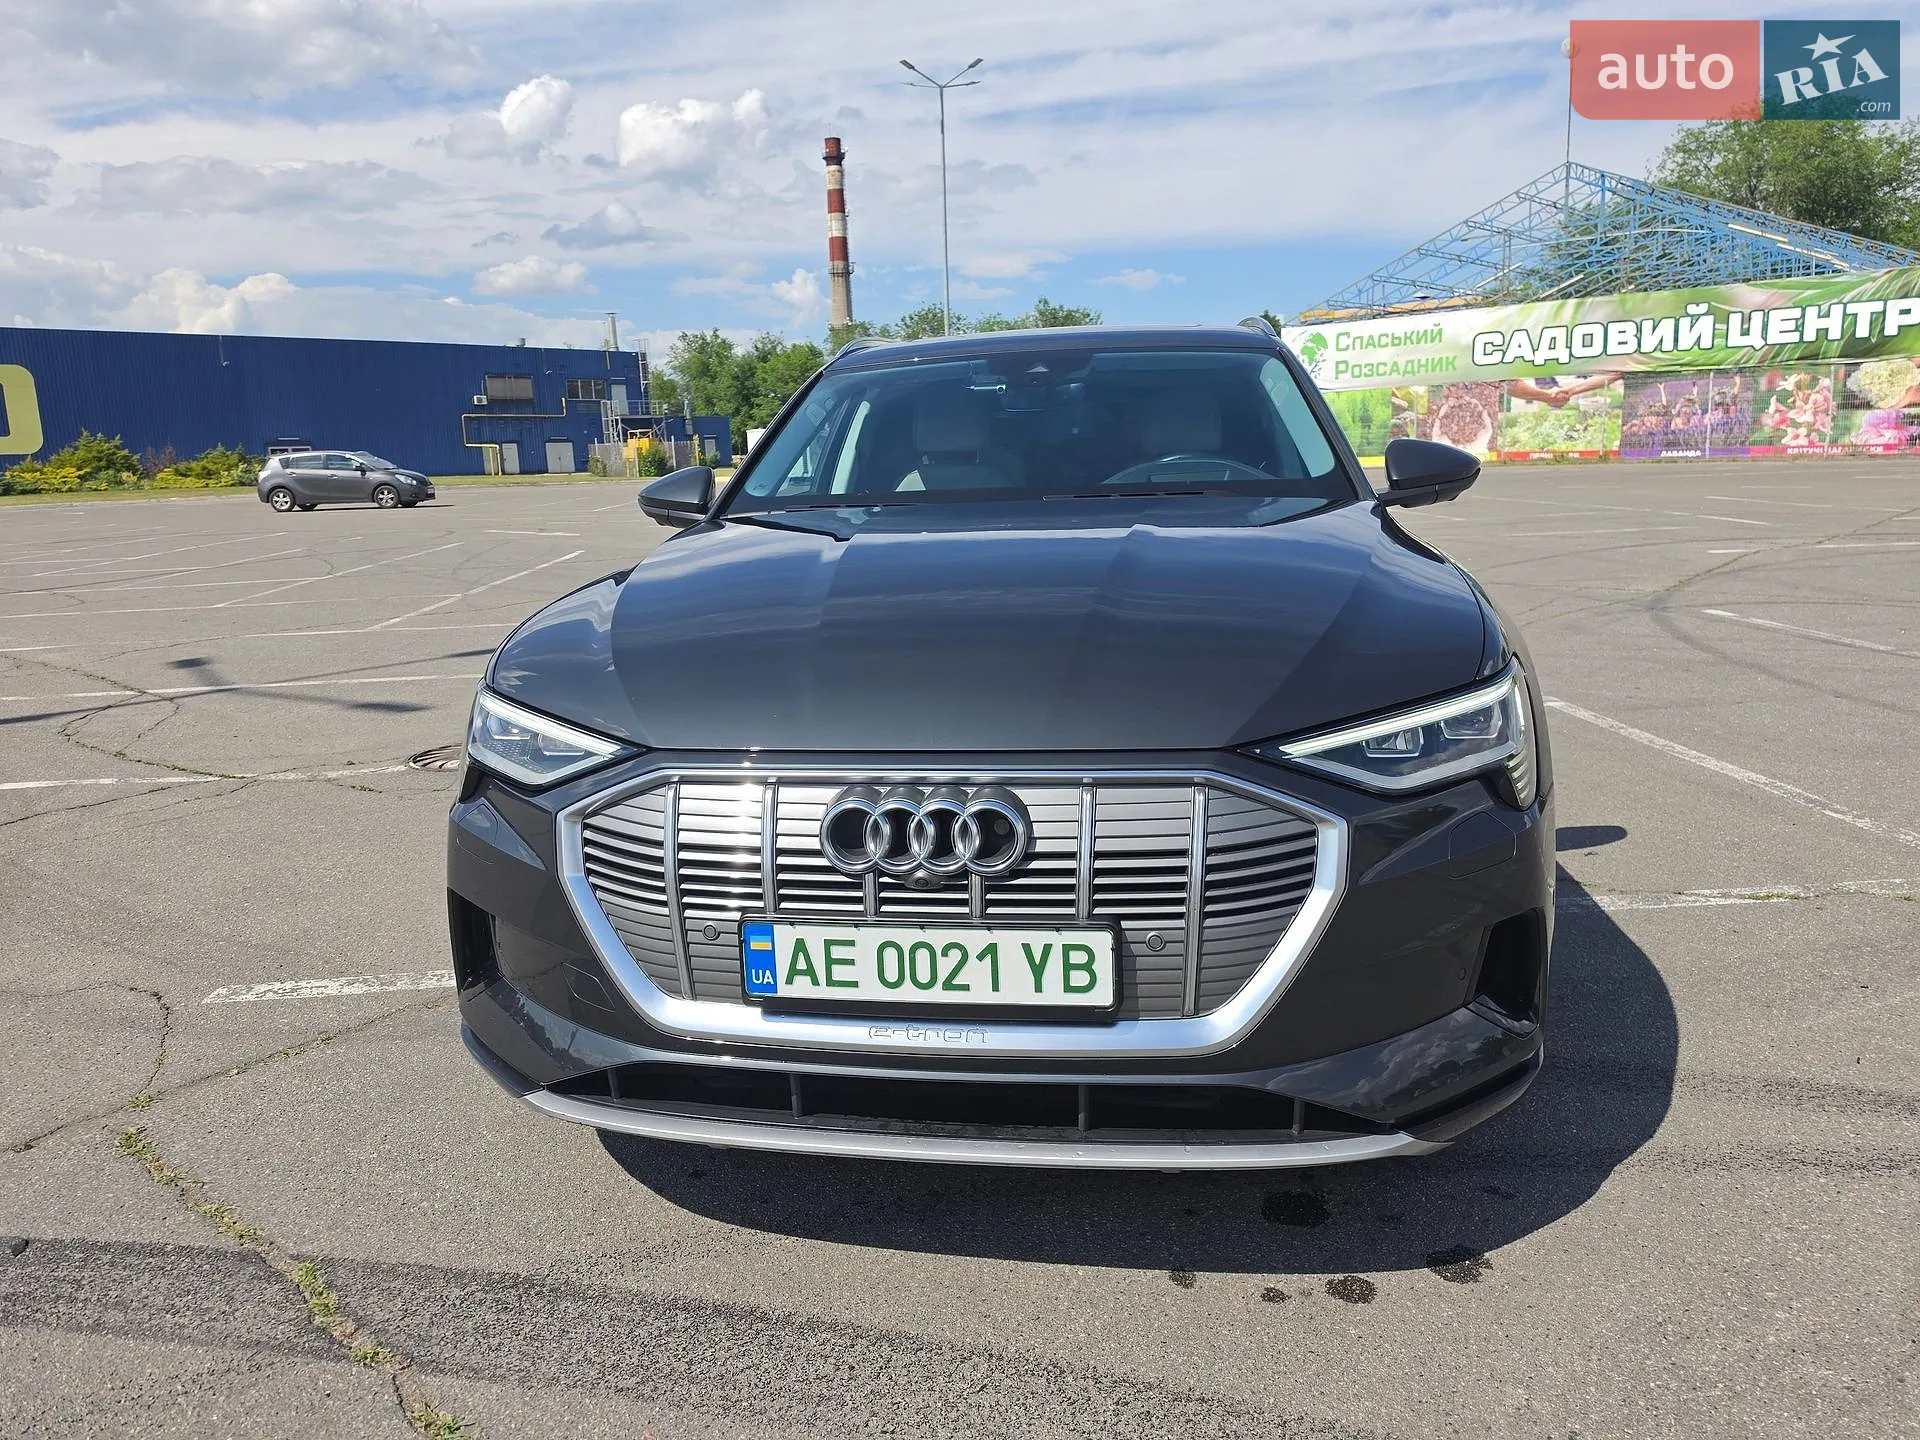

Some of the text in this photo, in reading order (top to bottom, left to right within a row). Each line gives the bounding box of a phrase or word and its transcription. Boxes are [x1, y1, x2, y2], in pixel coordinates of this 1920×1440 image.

[1472, 296, 1920, 366] САДОВИЙ ЦЕНТР
[751, 969, 775, 985] UA
[784, 937, 1098, 994] AE 0021 YB
[868, 1023, 989, 1044] e-tron
